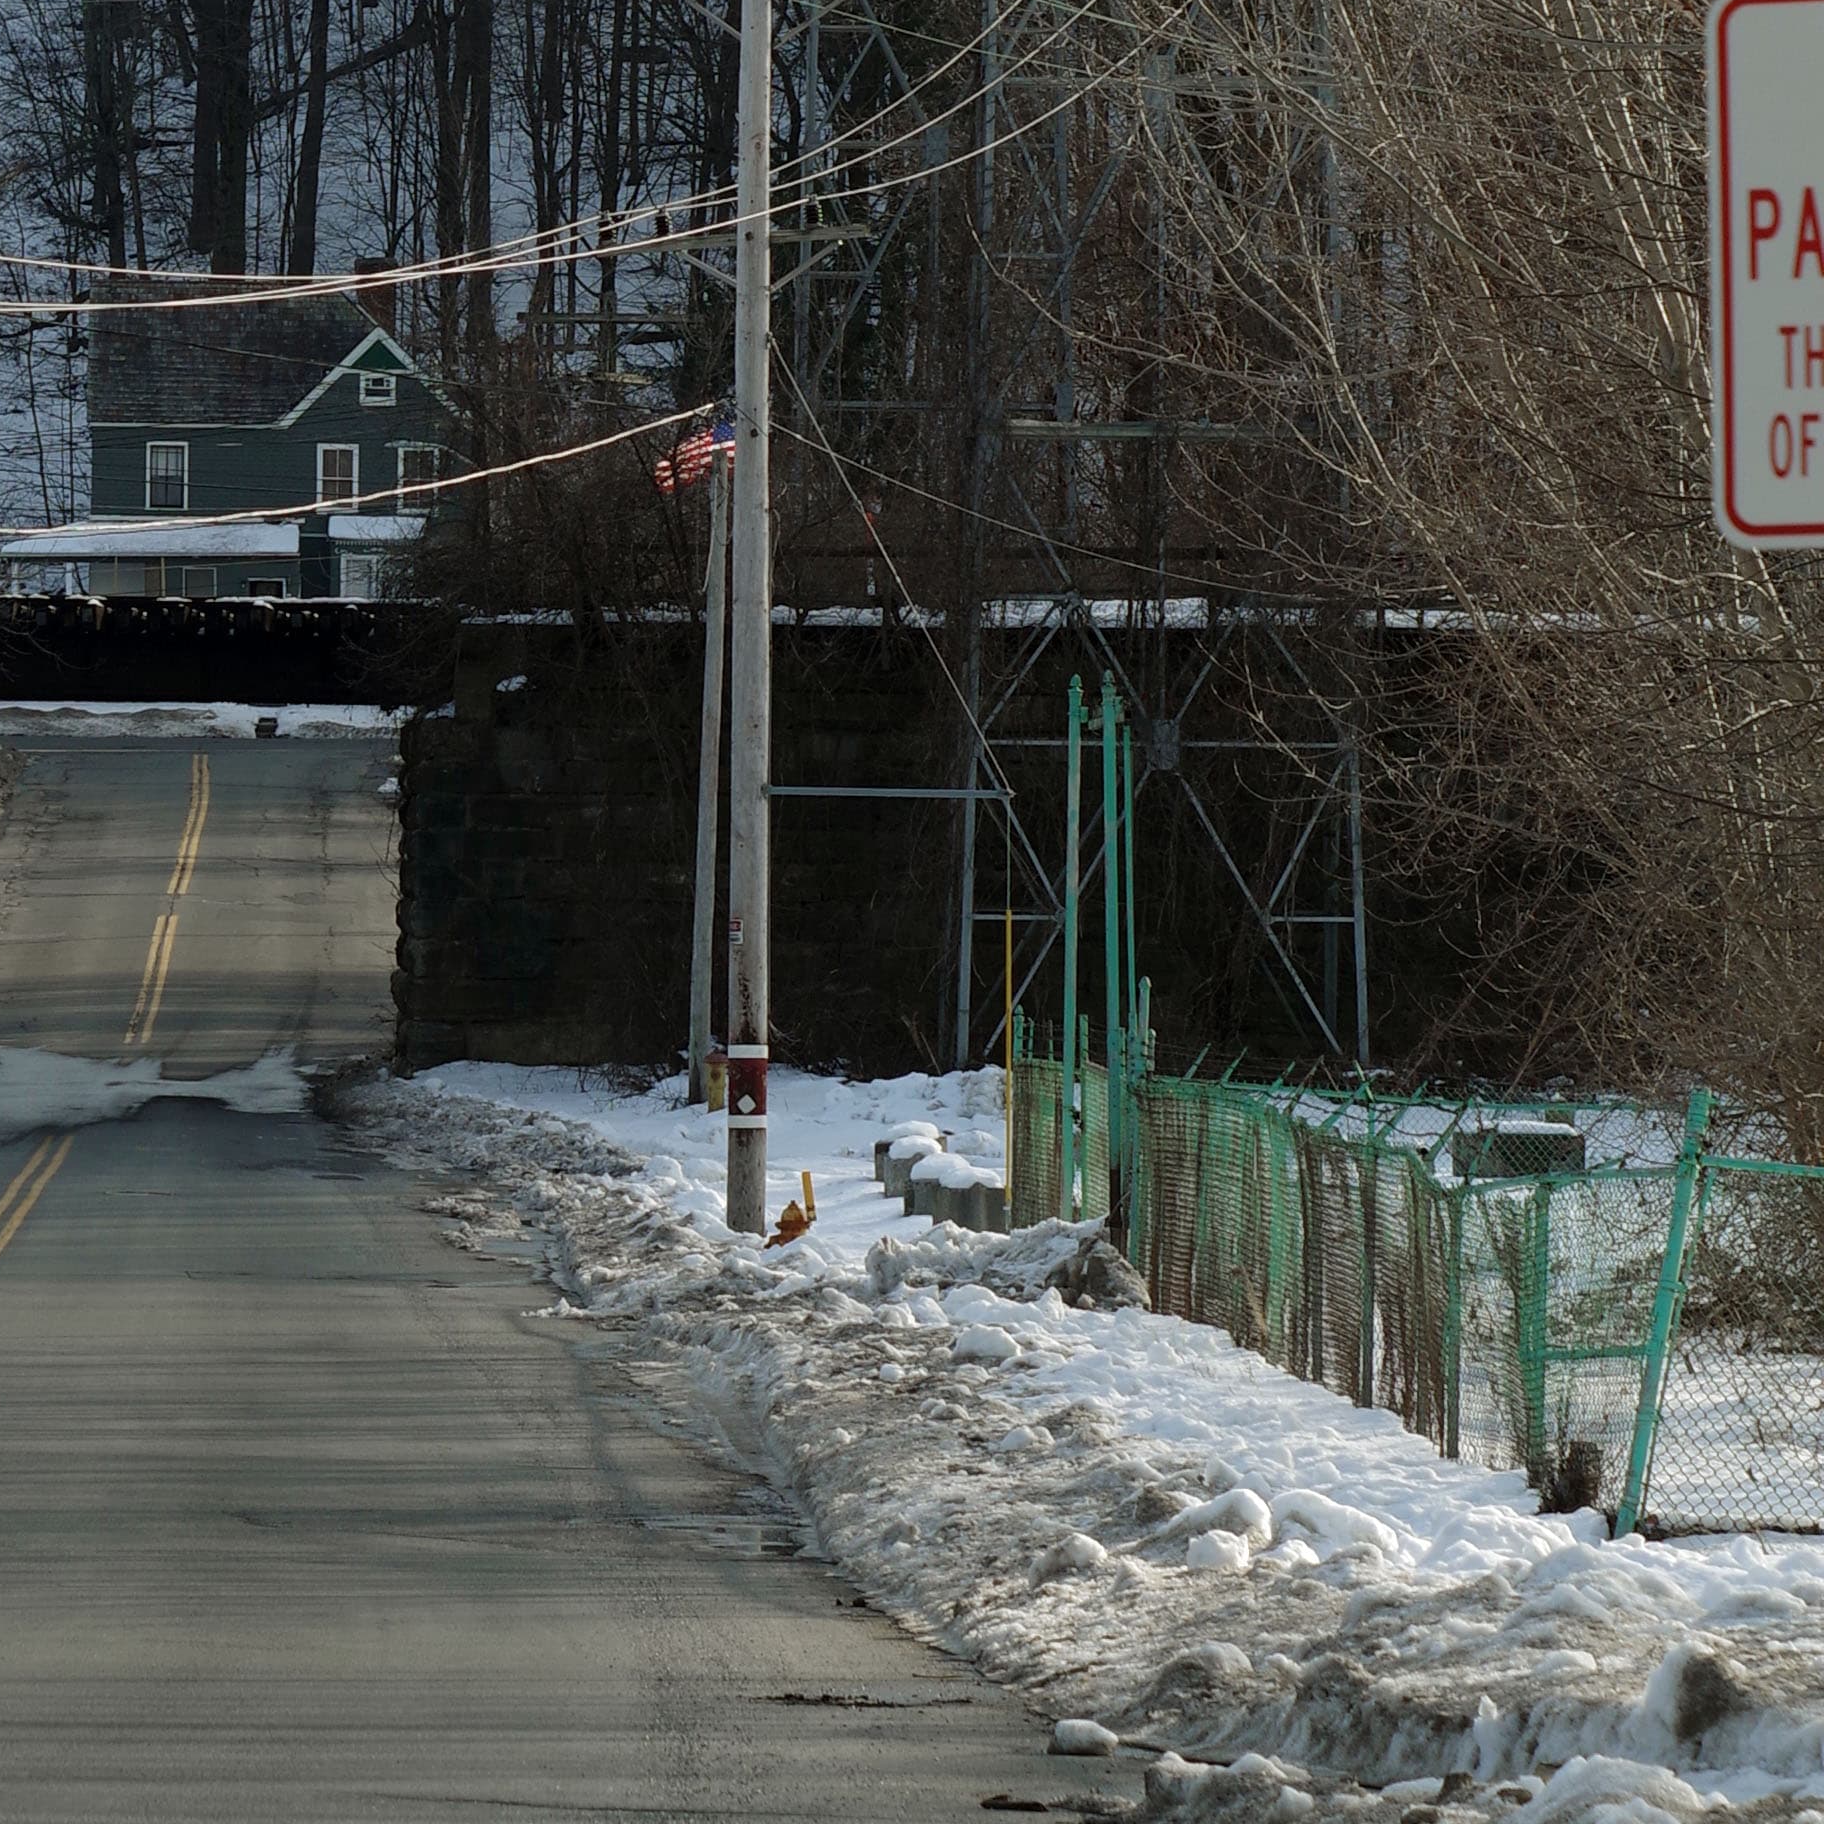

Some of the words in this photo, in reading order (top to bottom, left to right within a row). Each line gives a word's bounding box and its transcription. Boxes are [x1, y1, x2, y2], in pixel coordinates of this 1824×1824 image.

[1748, 186, 1824, 280] PA
[1779, 325, 1824, 388] TH
[1769, 413, 1820, 479] OF
